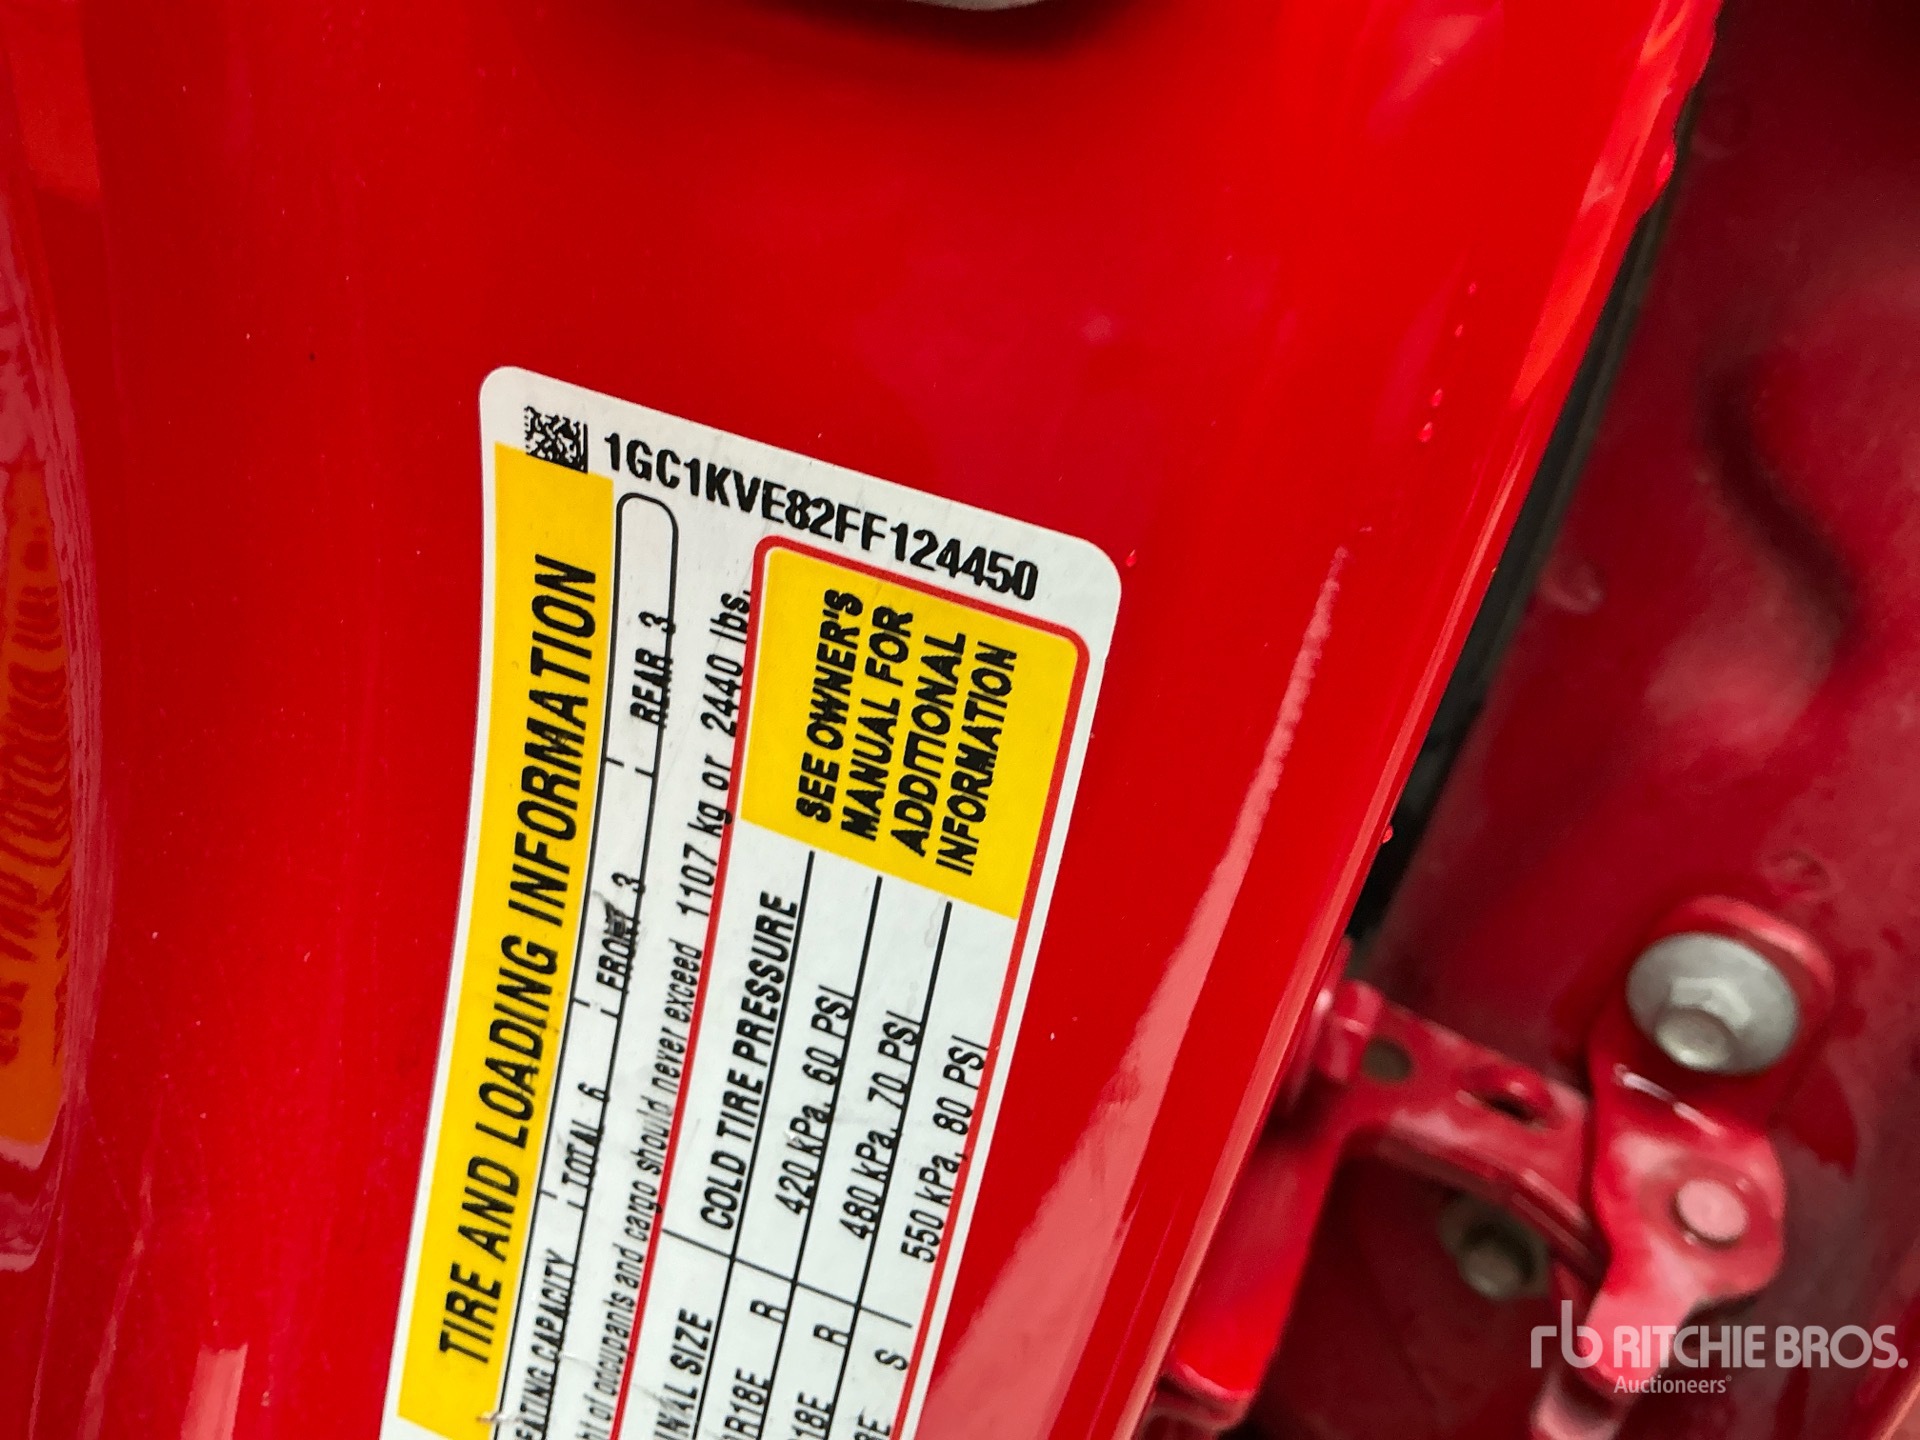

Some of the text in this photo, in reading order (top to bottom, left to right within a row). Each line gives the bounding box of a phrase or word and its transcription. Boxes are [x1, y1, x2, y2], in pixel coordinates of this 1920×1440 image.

[604, 432, 1038, 600] 1GC1KVE82FF124450
[638, 611, 676, 633] 3
[630, 647, 672, 728] REAR
[701, 654, 743, 737] 2440
[796, 589, 863, 823] SEE OWNER'S
[840, 605, 913, 842] MANUAL FOR
[890, 632, 966, 857] ADDITIONAL
[702, 754, 731, 791] or
[935, 641, 1018, 876] INFORMATION
[687, 799, 733, 838] kg
[611, 872, 645, 894] 3
[676, 843, 717, 917] 1107
[439, 553, 596, 1364] TIRE AND LOADING INFORMATION
[664, 938, 702, 1023] exceed
[811, 984, 854, 1040] PSI
[878, 1011, 922, 1065] PSI
[651, 1027, 687, 1094] never
[701, 891, 798, 1230] COLD TIRE PRESSURE
[802, 1047, 840, 1085] 60
[868, 1072, 907, 1110] 70
[943, 1035, 989, 1090] PSI
[578, 1081, 609, 1102] 6
[932, 1097, 973, 1135] 80
[562, 1120, 603, 1190] TOTAL
[630, 1095, 672, 1175] should
[624, 1180, 662, 1241] cargo
[775, 1160, 816, 1215] 420
[839, 1186, 881, 1240] 480
[613, 1242, 645, 1289] and
[901, 1209, 944, 1263] 550
[531, 1248, 575, 1362] CAPACITY
[669, 1309, 713, 1375] SIZE
[813, 1324, 851, 1349] R
[874, 1349, 908, 1371] S
[720, 1300, 787, 1440] R18E R
